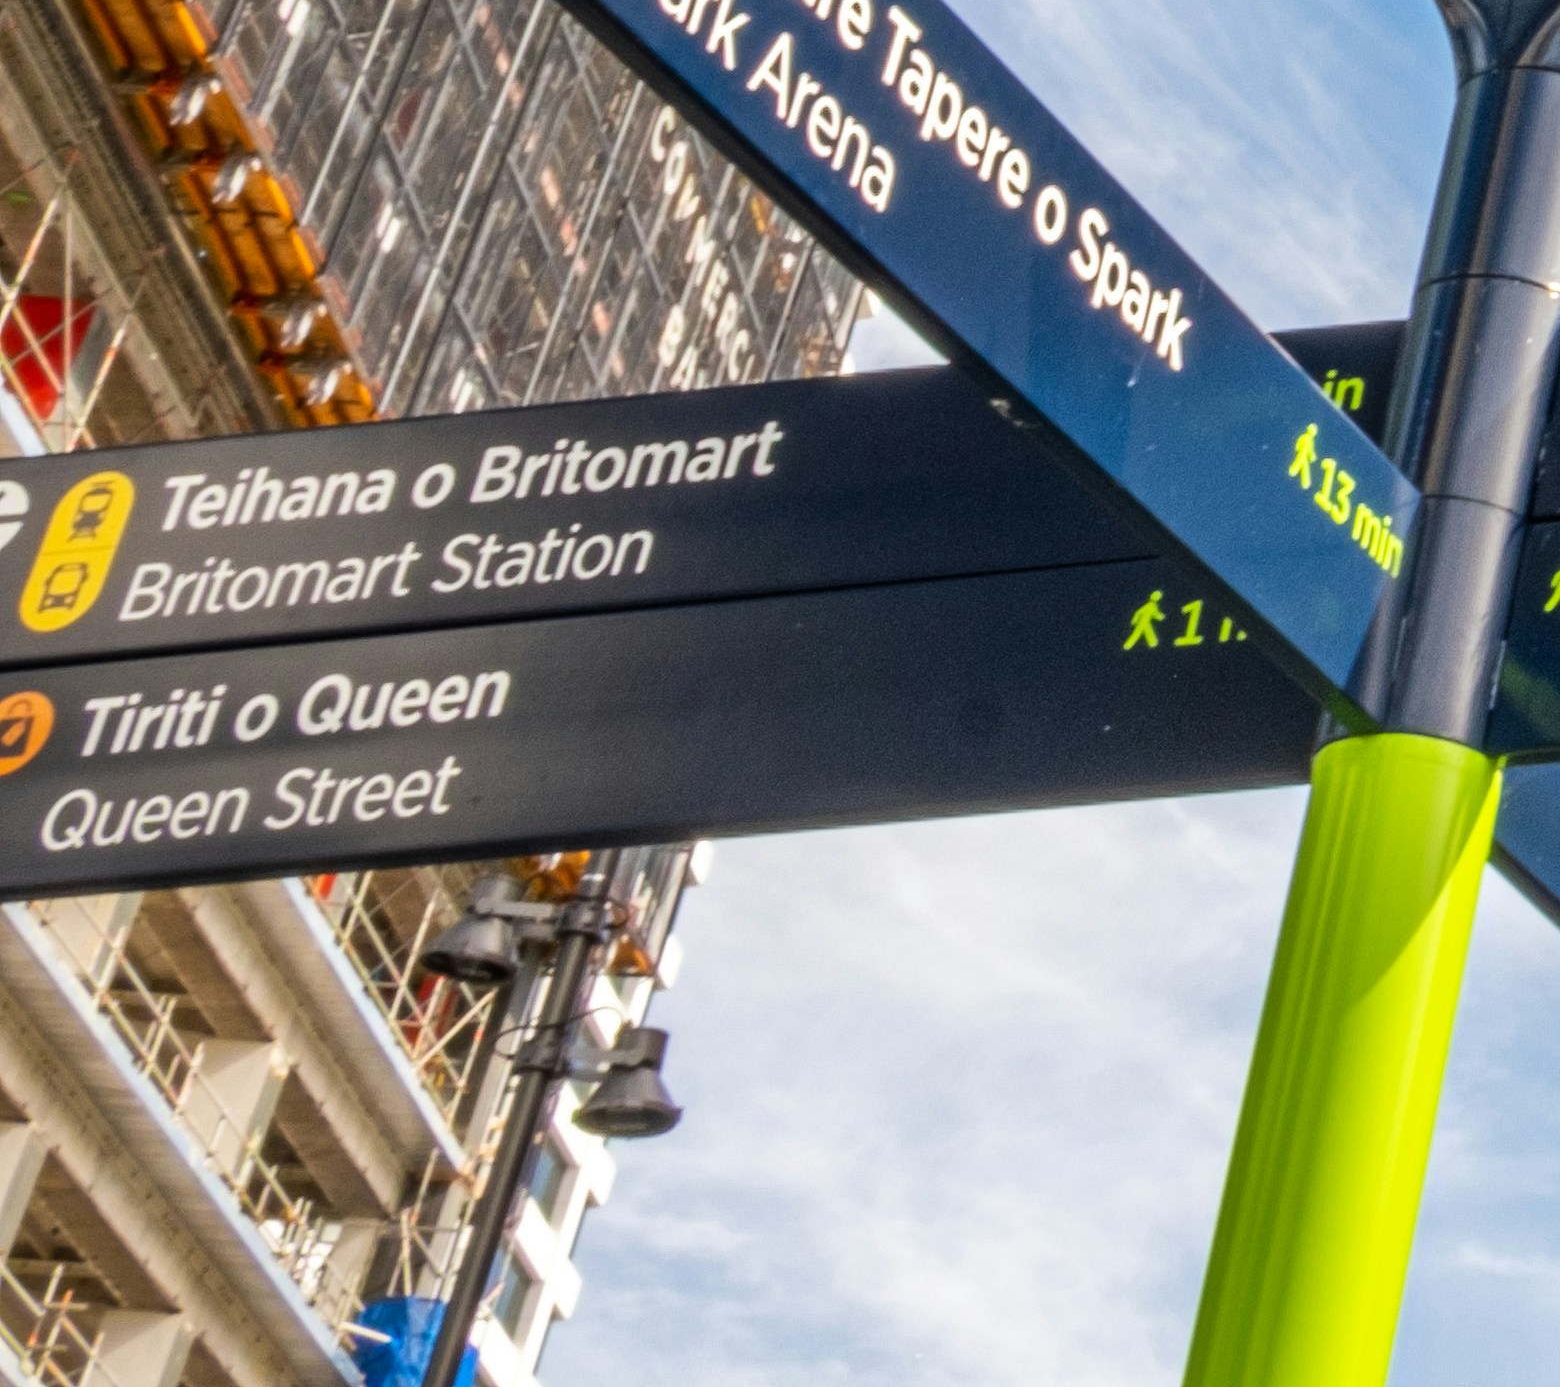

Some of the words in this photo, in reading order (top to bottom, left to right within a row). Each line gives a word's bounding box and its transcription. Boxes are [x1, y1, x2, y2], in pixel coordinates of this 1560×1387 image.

[746, 32, 896, 213] Arena
[881, 5, 1030, 209] Tapere
[1034, 185, 1067, 245] o
[1069, 208, 1192, 372] Spark
[652, 105, 755, 383] COMMERCI
[659, 305, 700, 391] BA
[1324, 370, 1364, 409] in
[161, 466, 397, 532] Teihana
[411, 463, 455, 508] o
[470, 421, 783, 503] Britomart
[1314, 459, 1354, 524] 13
[1352, 505, 1403, 575] min
[118, 542, 422, 621] Britomart
[431, 523, 653, 592] Station
[82, 683, 227, 756] Tiriti
[234, 694, 278, 741] o
[297, 671, 510, 735] Queen
[41, 787, 250, 851] Queen
[263, 756, 463, 829] Street
